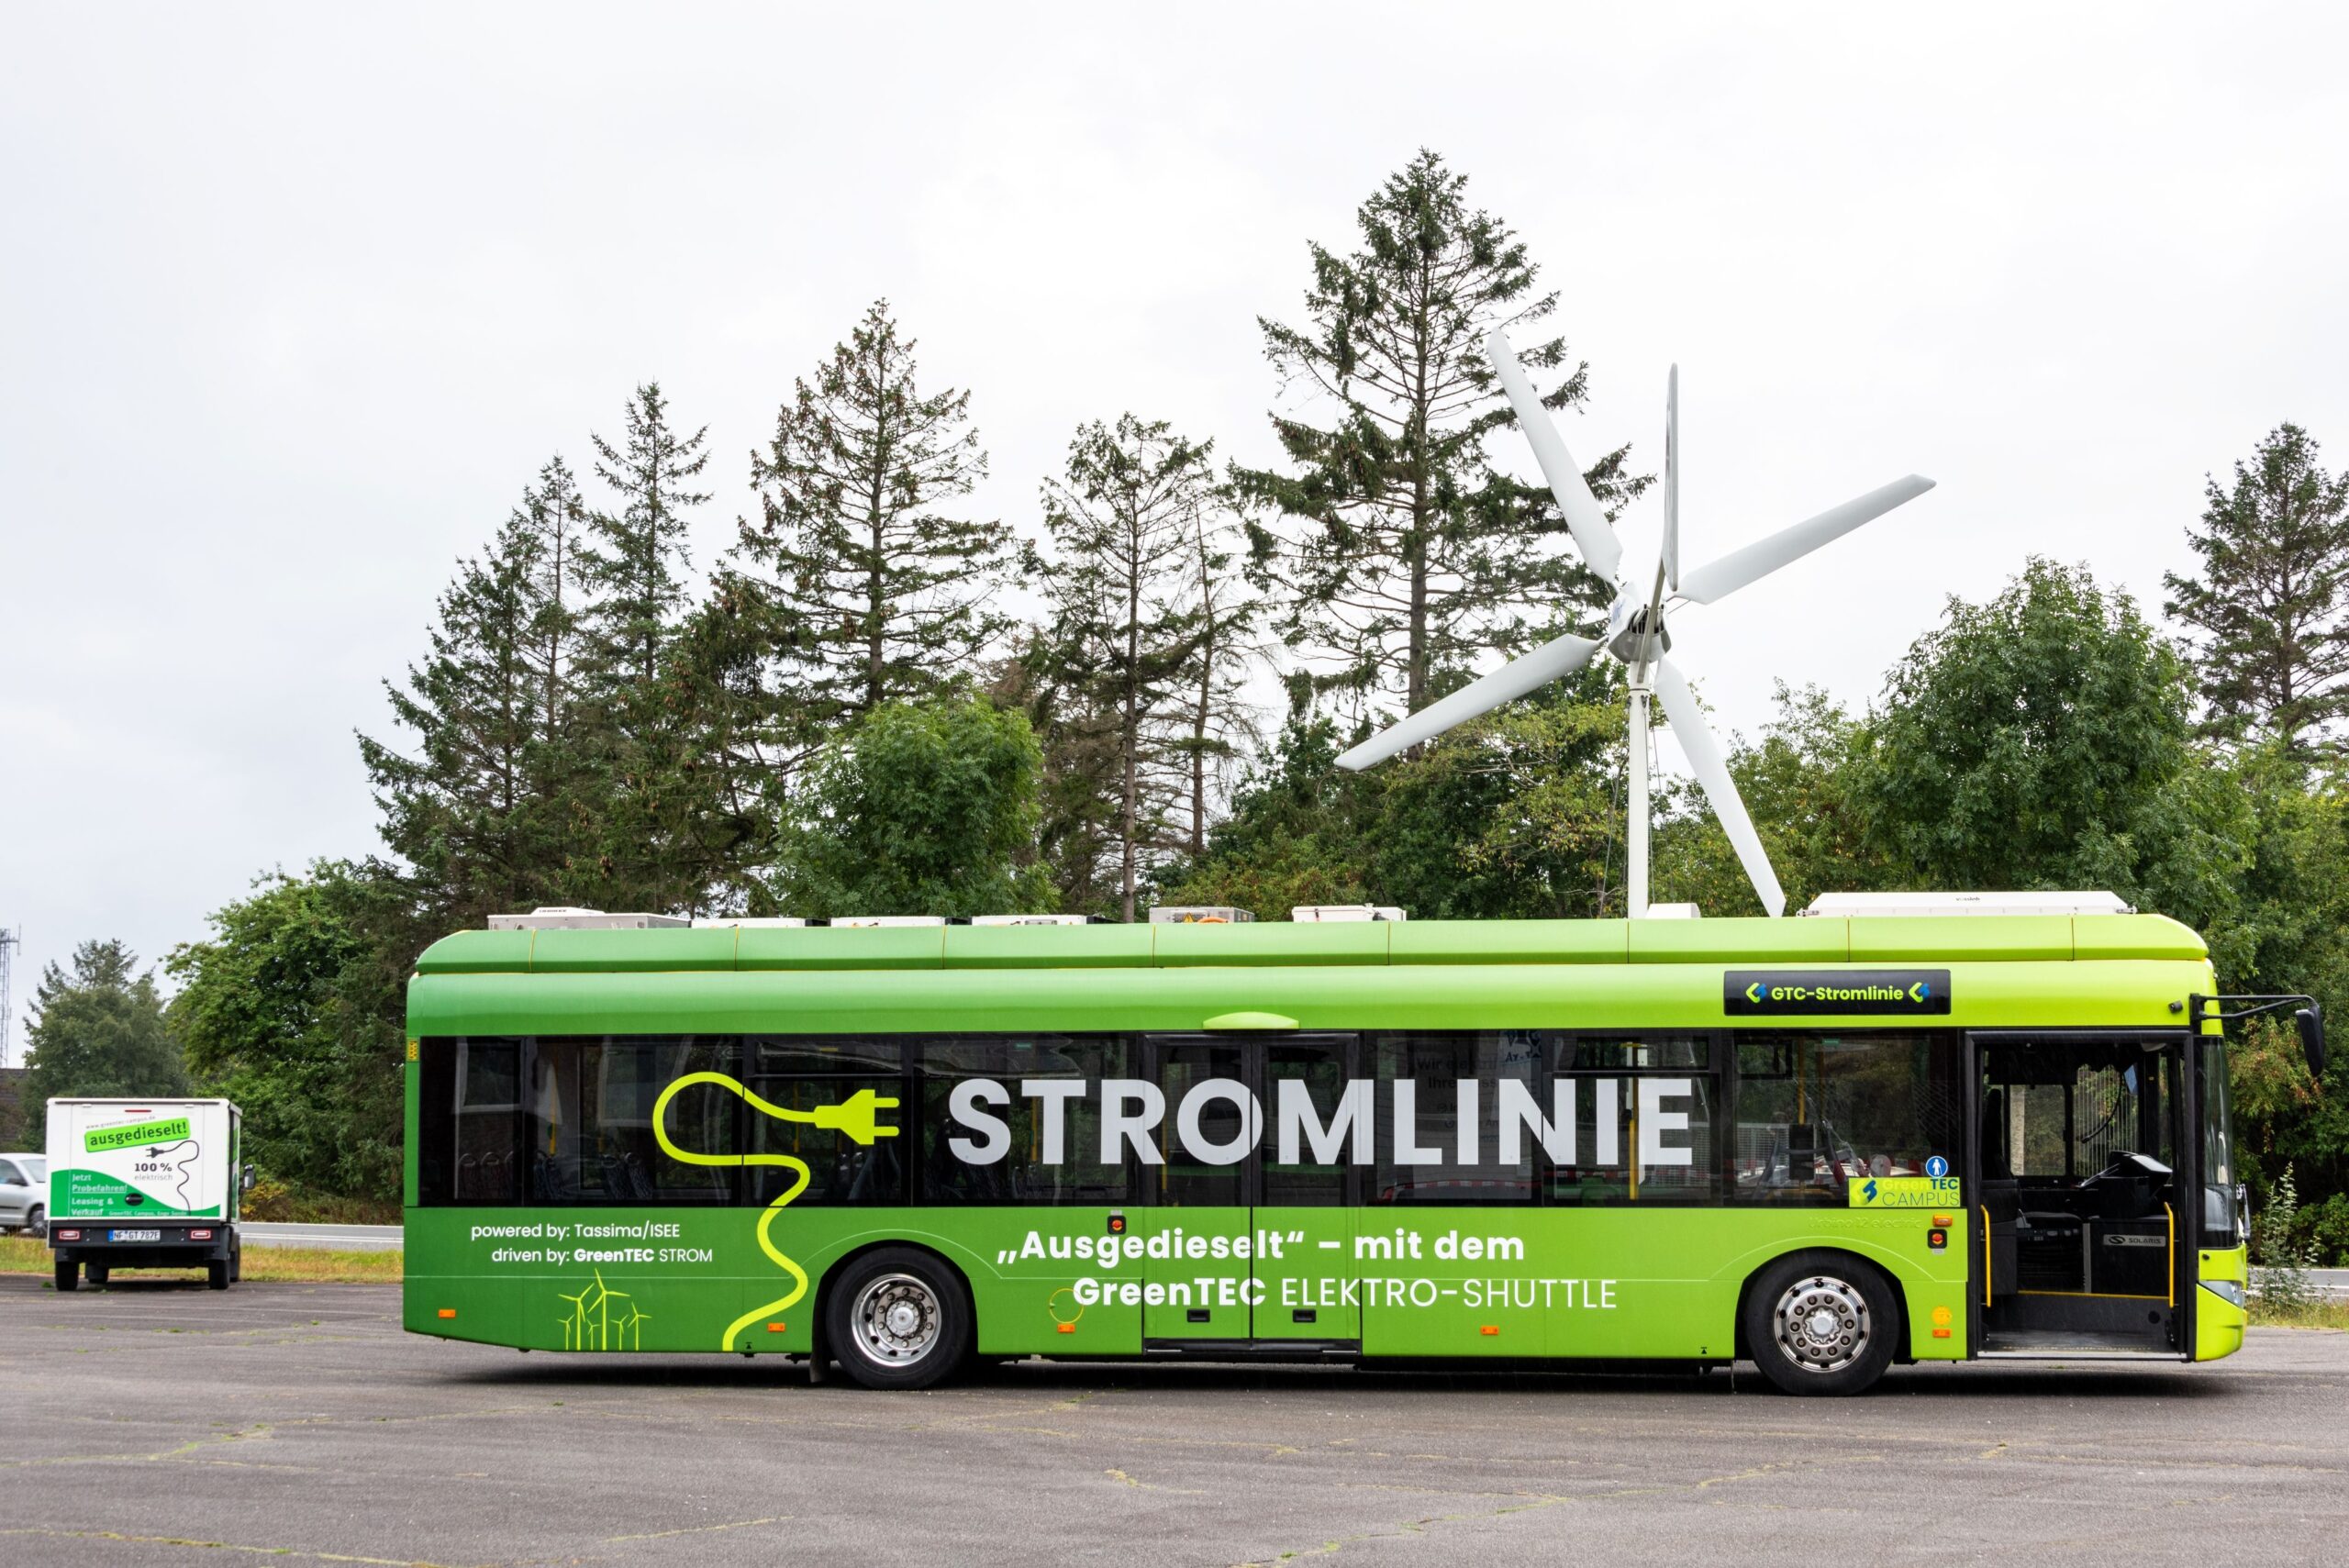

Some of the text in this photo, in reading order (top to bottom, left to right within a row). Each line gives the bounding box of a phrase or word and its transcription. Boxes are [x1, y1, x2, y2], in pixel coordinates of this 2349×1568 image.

[1771, 985, 1904, 1001] GTC-Stromlinie
[948, 1078, 1693, 1165] STROMLINIE
[90, 1121, 187, 1145] ausgedieselt!
[135, 1162, 173, 1172] 100 %
[72, 1173, 92, 1183] Jetzt
[1882, 1178, 1959, 1190] GreenTEC
[72, 1184, 128, 1193] Probefahren!
[72, 1197, 104, 1207] Leasing
[1882, 1192, 1959, 1207] CAMPUS
[71, 1208, 104, 1217] Verkauf
[471, 1220, 680, 1241] powered by: Tassima/ISEE
[1354, 1228, 1422, 1260] mit
[1434, 1229, 1524, 1260] dem
[491, 1248, 713, 1265] driven by: GreenTEC STROM
[1073, 1278, 1617, 1308] GreenTEC ELEKTRO-SHUTTLE
